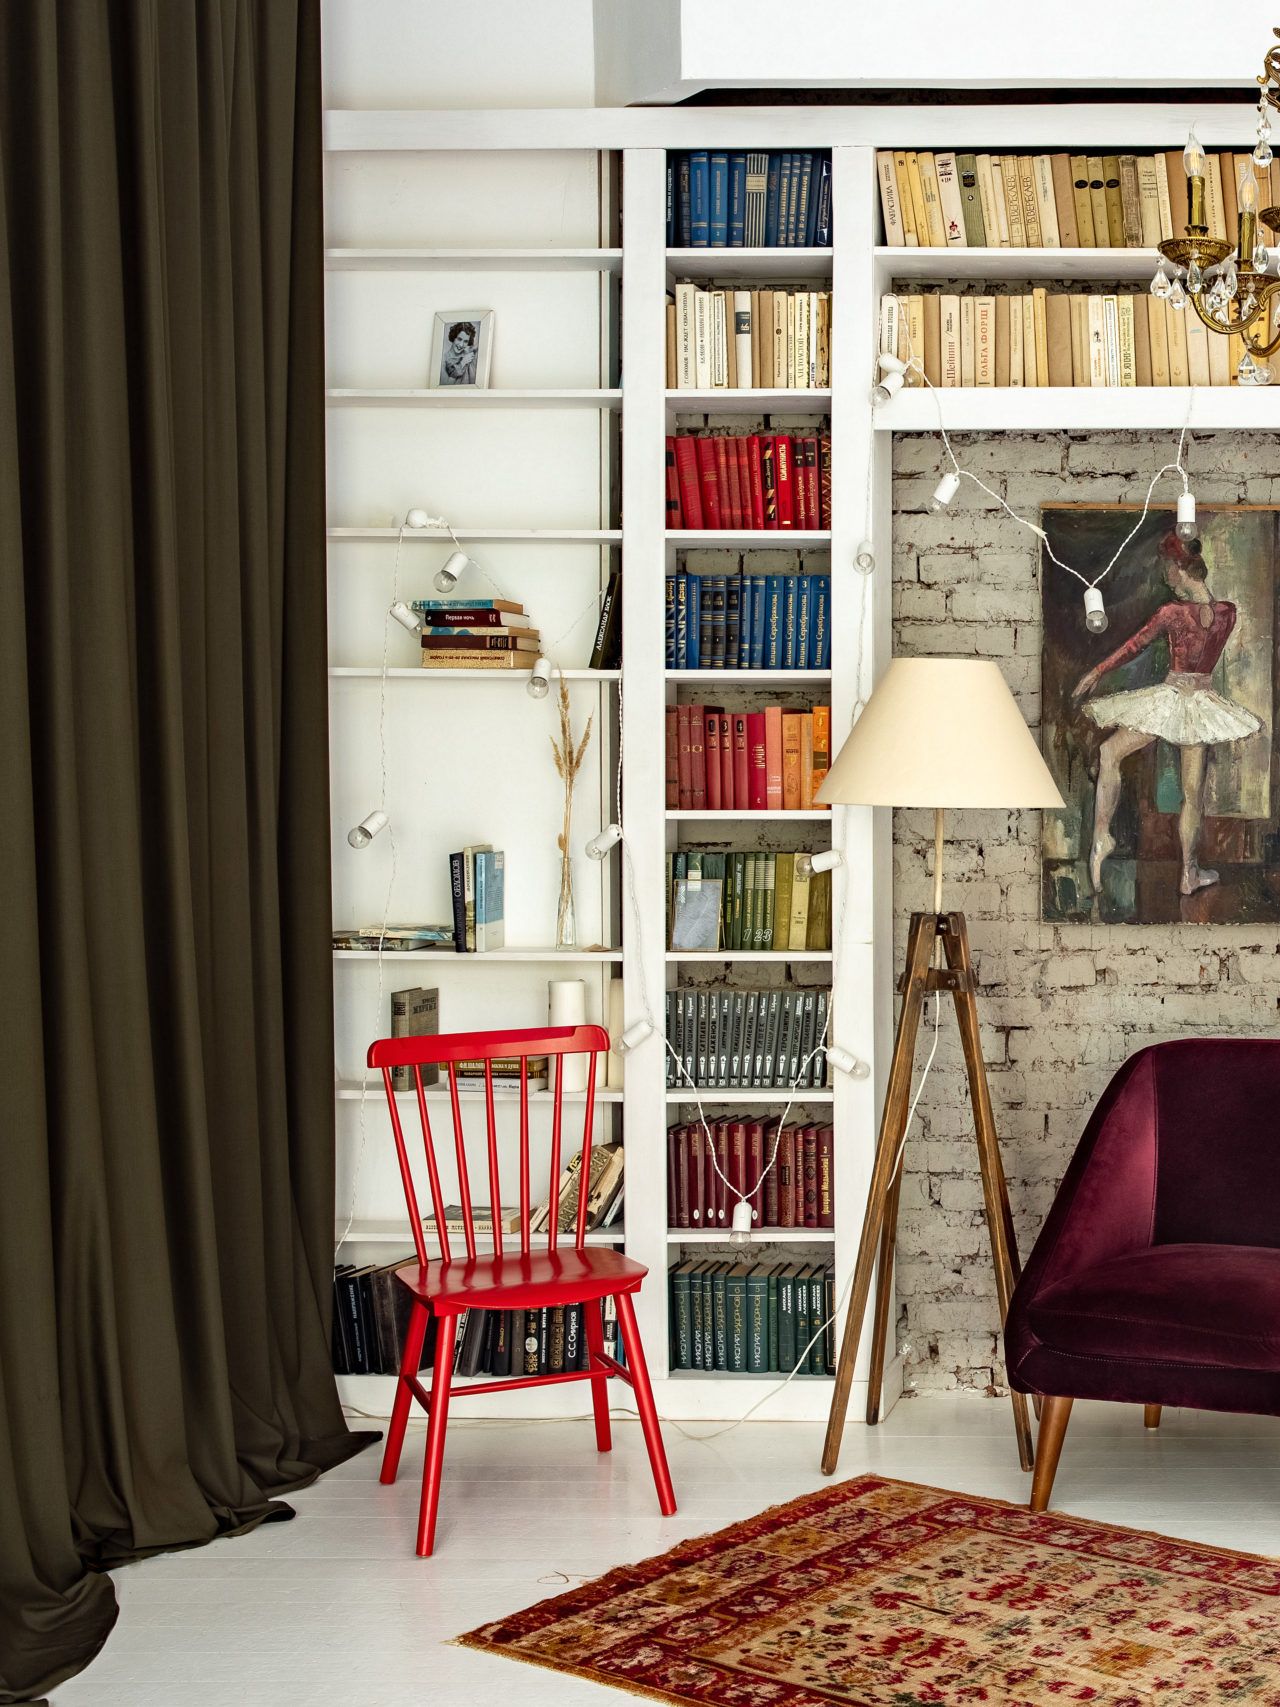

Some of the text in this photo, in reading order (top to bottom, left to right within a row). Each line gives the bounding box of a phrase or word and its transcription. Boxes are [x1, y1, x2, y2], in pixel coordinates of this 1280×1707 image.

[779, 444, 788, 481] КОММУНИСТЫ
[595, 595, 612, 651] АЛЕКСАНДР БЛОК
[769, 594, 779, 640] Серебрякова
[785, 593, 795, 640] Серебрякова
[798, 594, 808, 641] Серебрякова
[815, 594, 825, 640] Серебрякова
[452, 860, 462, 897] ОБЛОМОВ
[757, 1022, 765, 1049] ГАШЕК
[821, 1191, 830, 1215] Григорий
[568, 1311, 579, 1342] Смирнов
[716, 1293, 724, 1329] ЗАДОРНОВ
[733, 1296, 742, 1334] ЗАДОРНОВ
[754, 1296, 763, 1334] ЗАДОРНОВ
